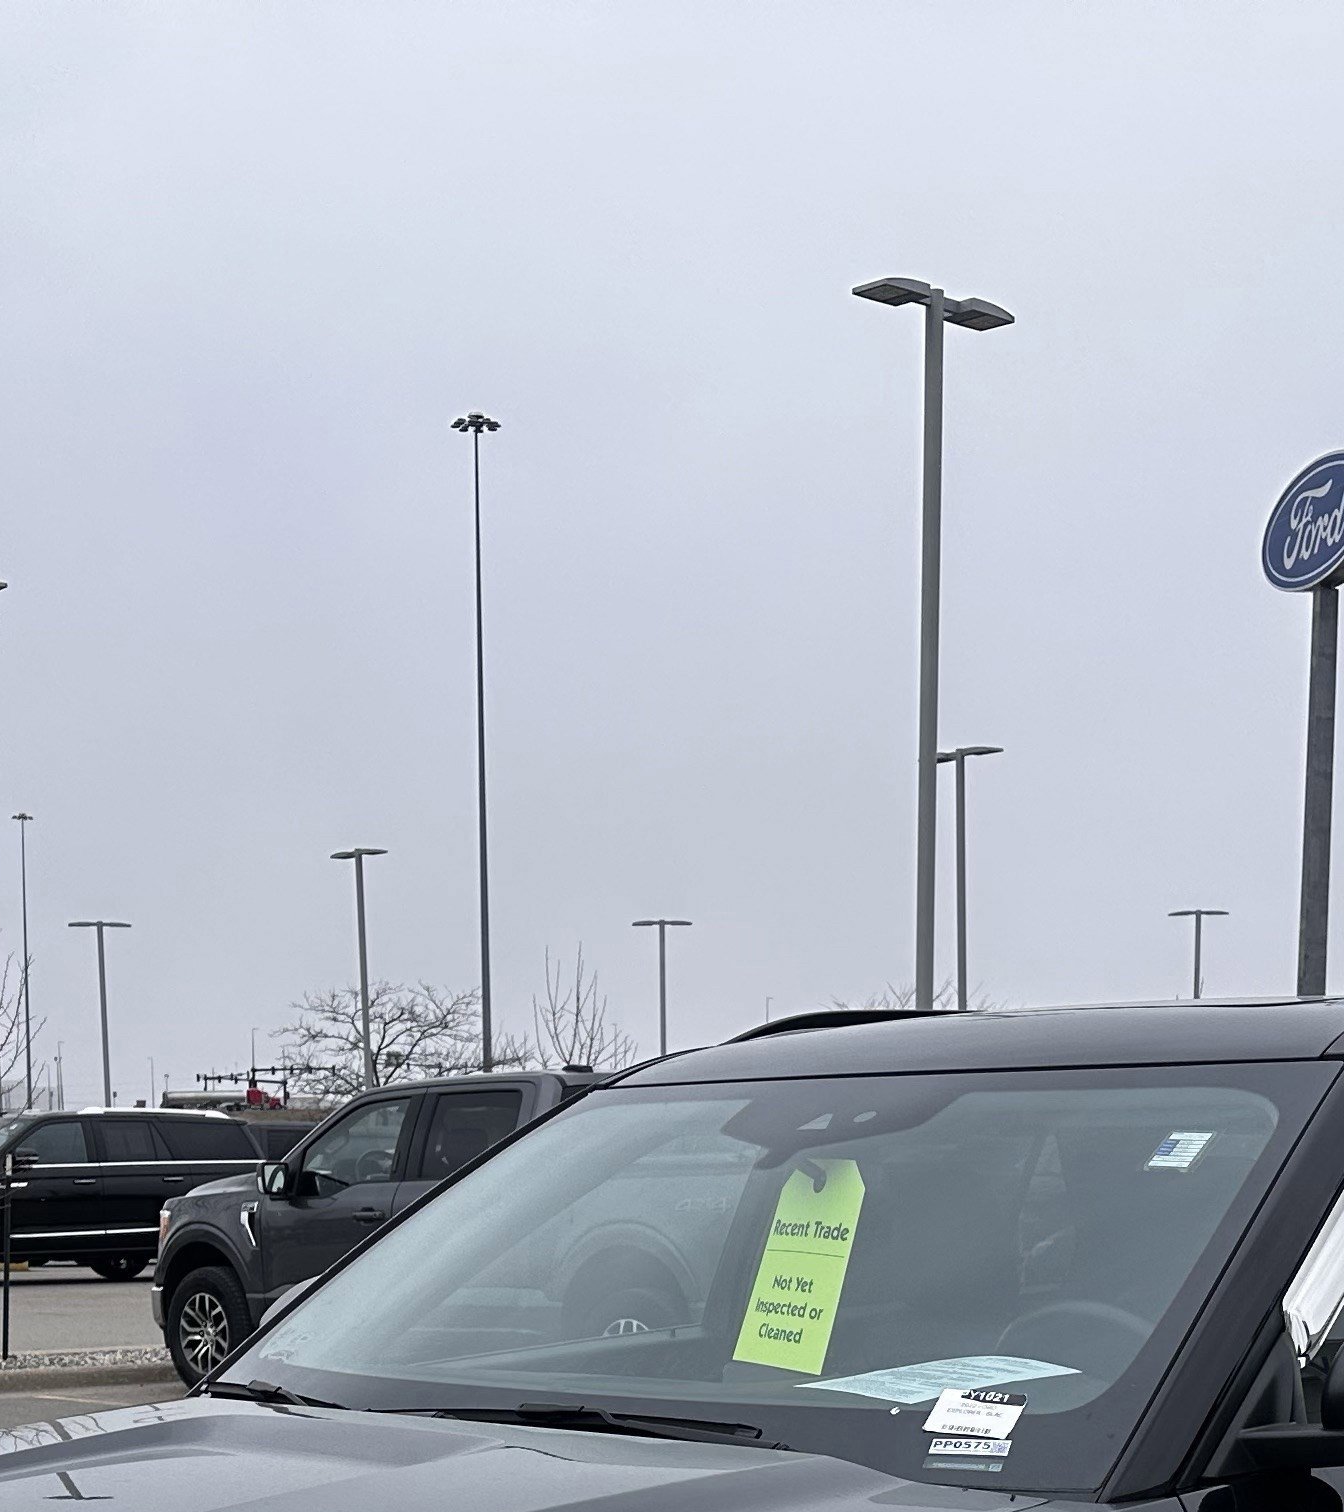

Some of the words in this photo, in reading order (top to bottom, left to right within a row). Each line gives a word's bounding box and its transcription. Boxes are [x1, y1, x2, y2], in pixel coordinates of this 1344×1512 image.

[773, 1219, 810, 1238] Recent
[813, 1221, 850, 1242] Trade
[772, 1275, 792, 1292] Not
[795, 1276, 814, 1294] Yet
[755, 1298, 808, 1319] Inspected
[809, 1307, 824, 1321] or
[758, 1322, 804, 1344] Cleaned
